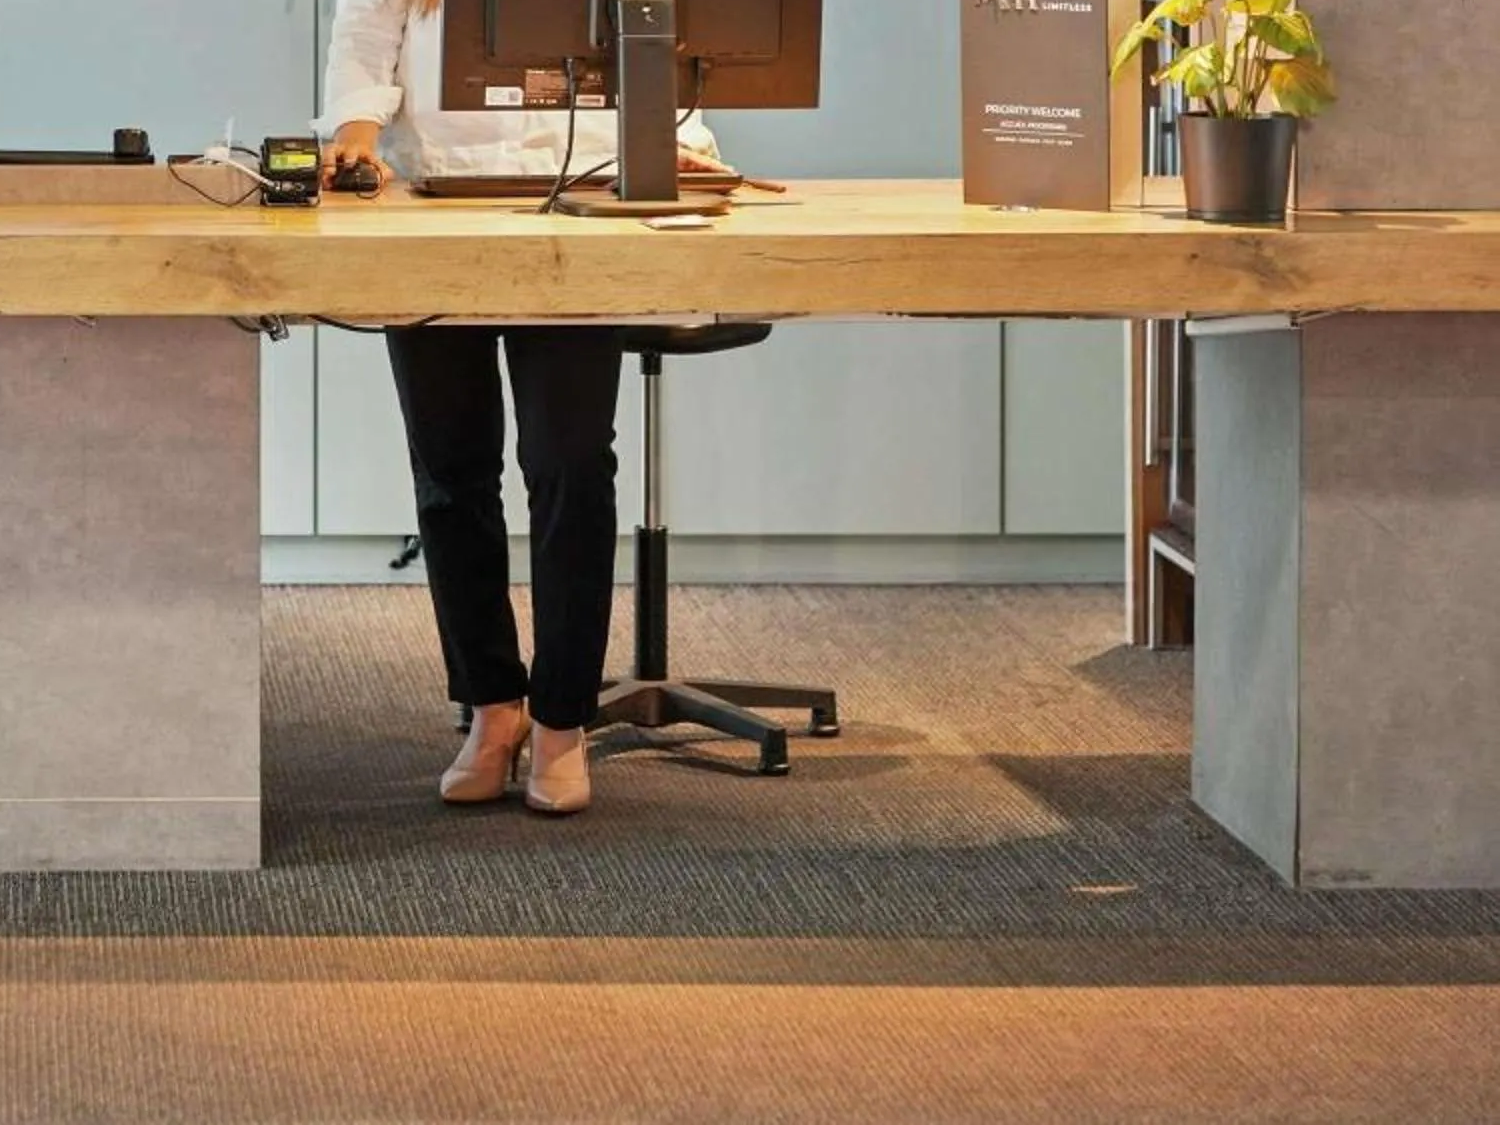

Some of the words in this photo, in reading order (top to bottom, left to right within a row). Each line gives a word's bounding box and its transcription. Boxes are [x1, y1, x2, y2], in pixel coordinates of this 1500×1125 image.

[1041, 2, 1093, 13] LIMITLESS
[985, 104, 1030, 117] PRIORITY
[1031, 106, 1082, 119] WELCOME
